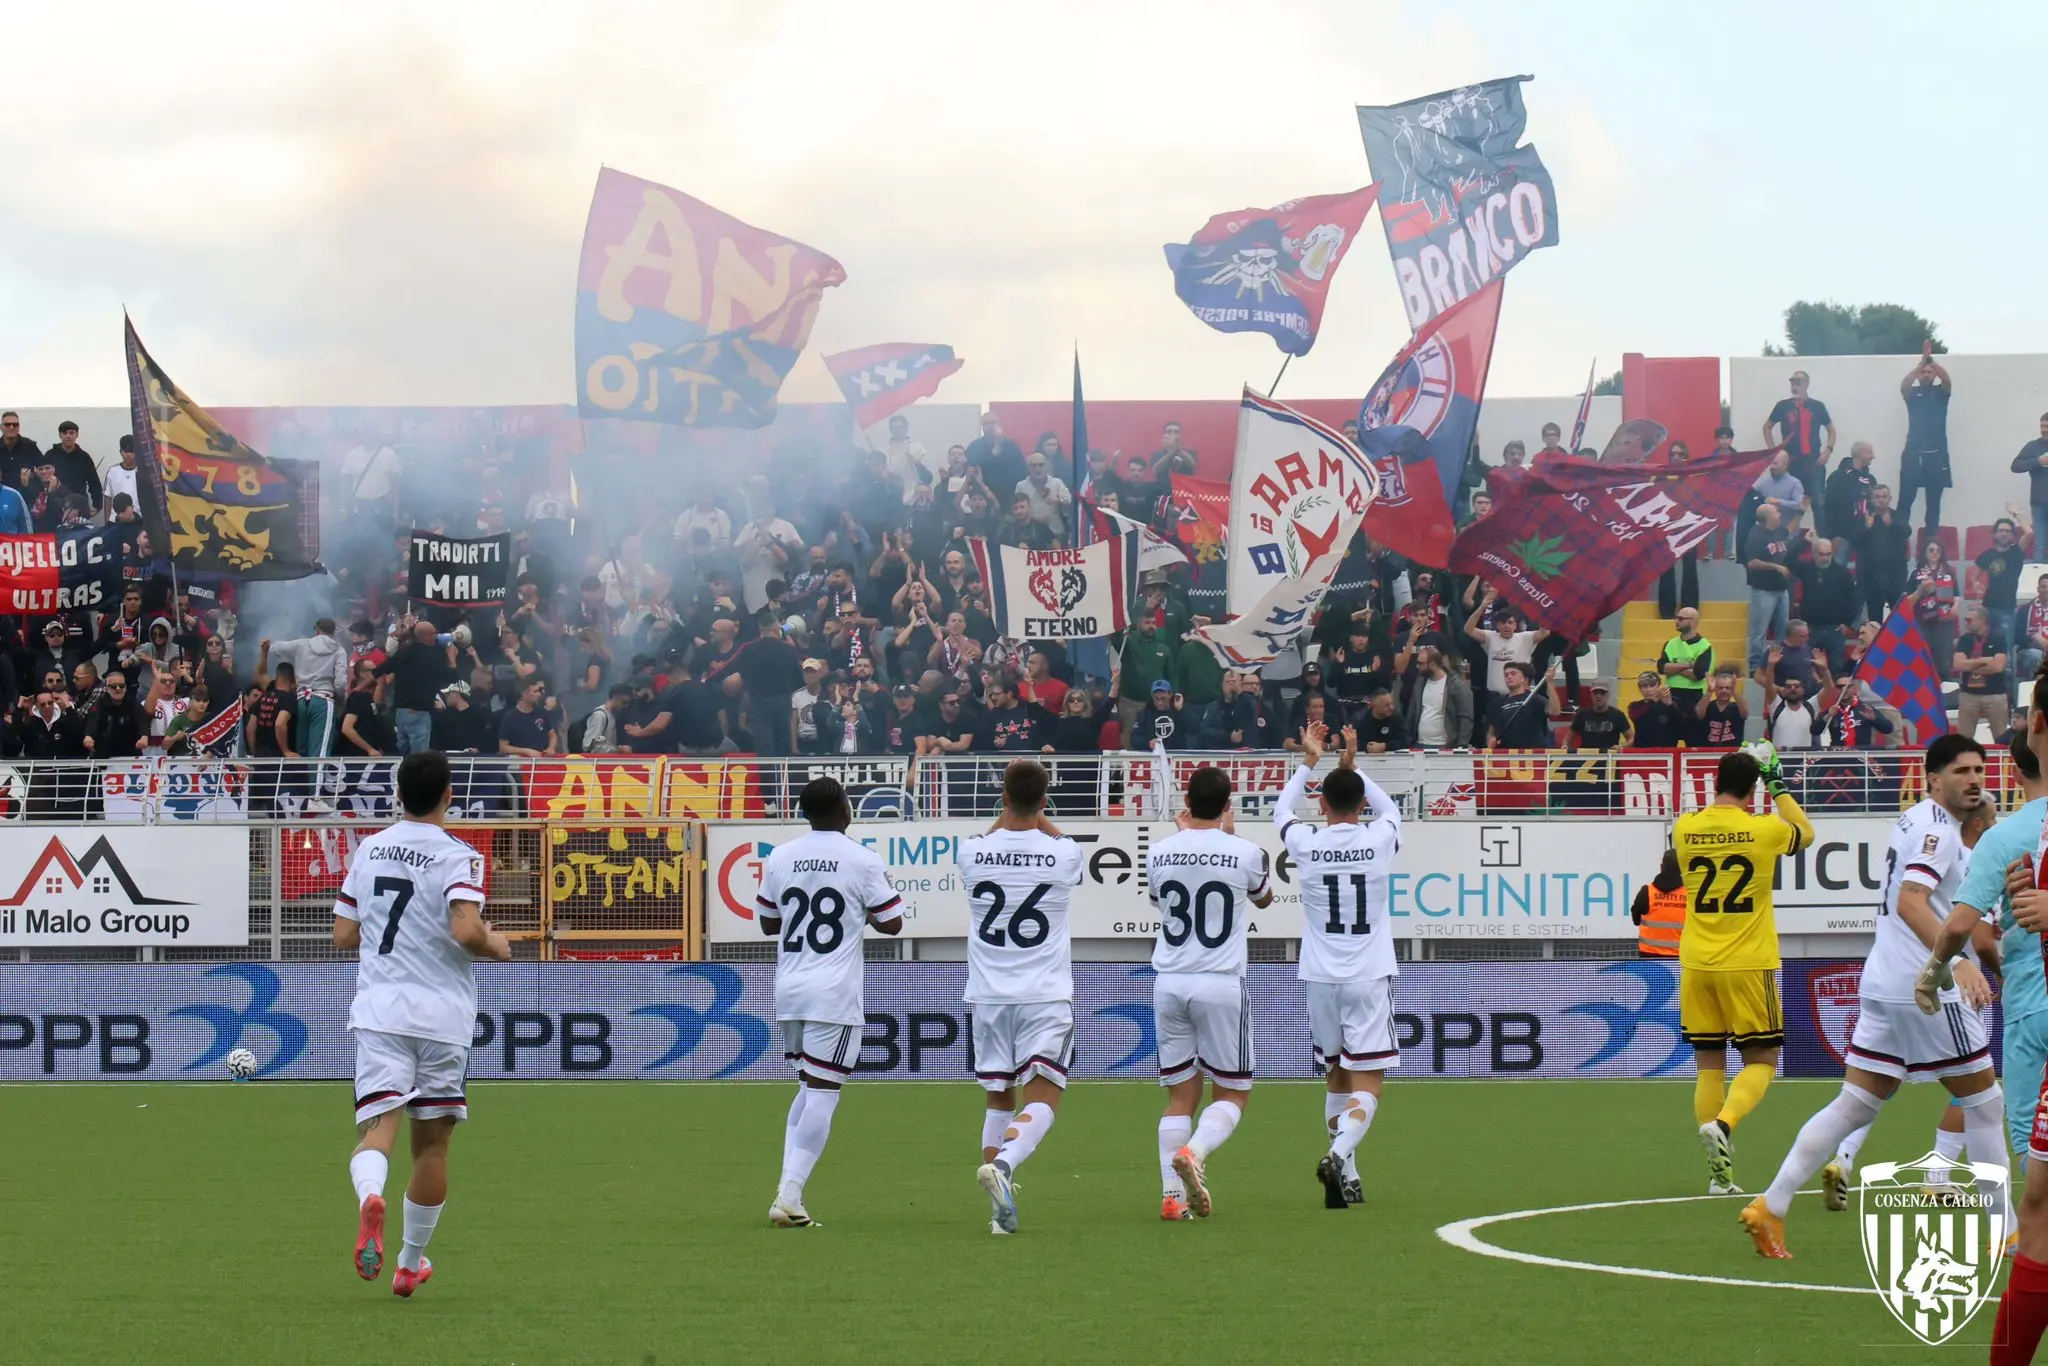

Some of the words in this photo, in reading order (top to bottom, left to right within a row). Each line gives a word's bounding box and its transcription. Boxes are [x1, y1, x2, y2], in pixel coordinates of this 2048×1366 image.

[1396, 182, 1546, 328] BRANCO
[412, 538, 501, 565] TRADIRTI
[1026, 548, 1086, 567] AMORE
[12, 581, 103, 610] ULTRAS
[425, 574, 479, 600] MAI
[1025, 616, 1097, 637] ETERNO
[1684, 831, 1755, 845] VETTOREL
[793, 859, 839, 873] KOUAN
[975, 852, 1056, 867] DAMETTO
[1152, 853, 1240, 869] MAZZOCCHI
[1311, 848, 1375, 862] D'ORAZIO
[1688, 854, 1755, 914] 22
[373, 876, 415, 955] 7
[972, 880, 1050, 948] 26
[1159, 880, 1235, 949] 30
[1323, 874, 1371, 935] 11
[26, 909, 91, 934] Malo
[100, 908, 190, 939] Group
[781, 886, 846, 955] 28
[1415, 924, 1506, 936] STRUTTURE
[1513, 924, 1521, 936] E
[1528, 924, 1588, 936] SISTEMI
